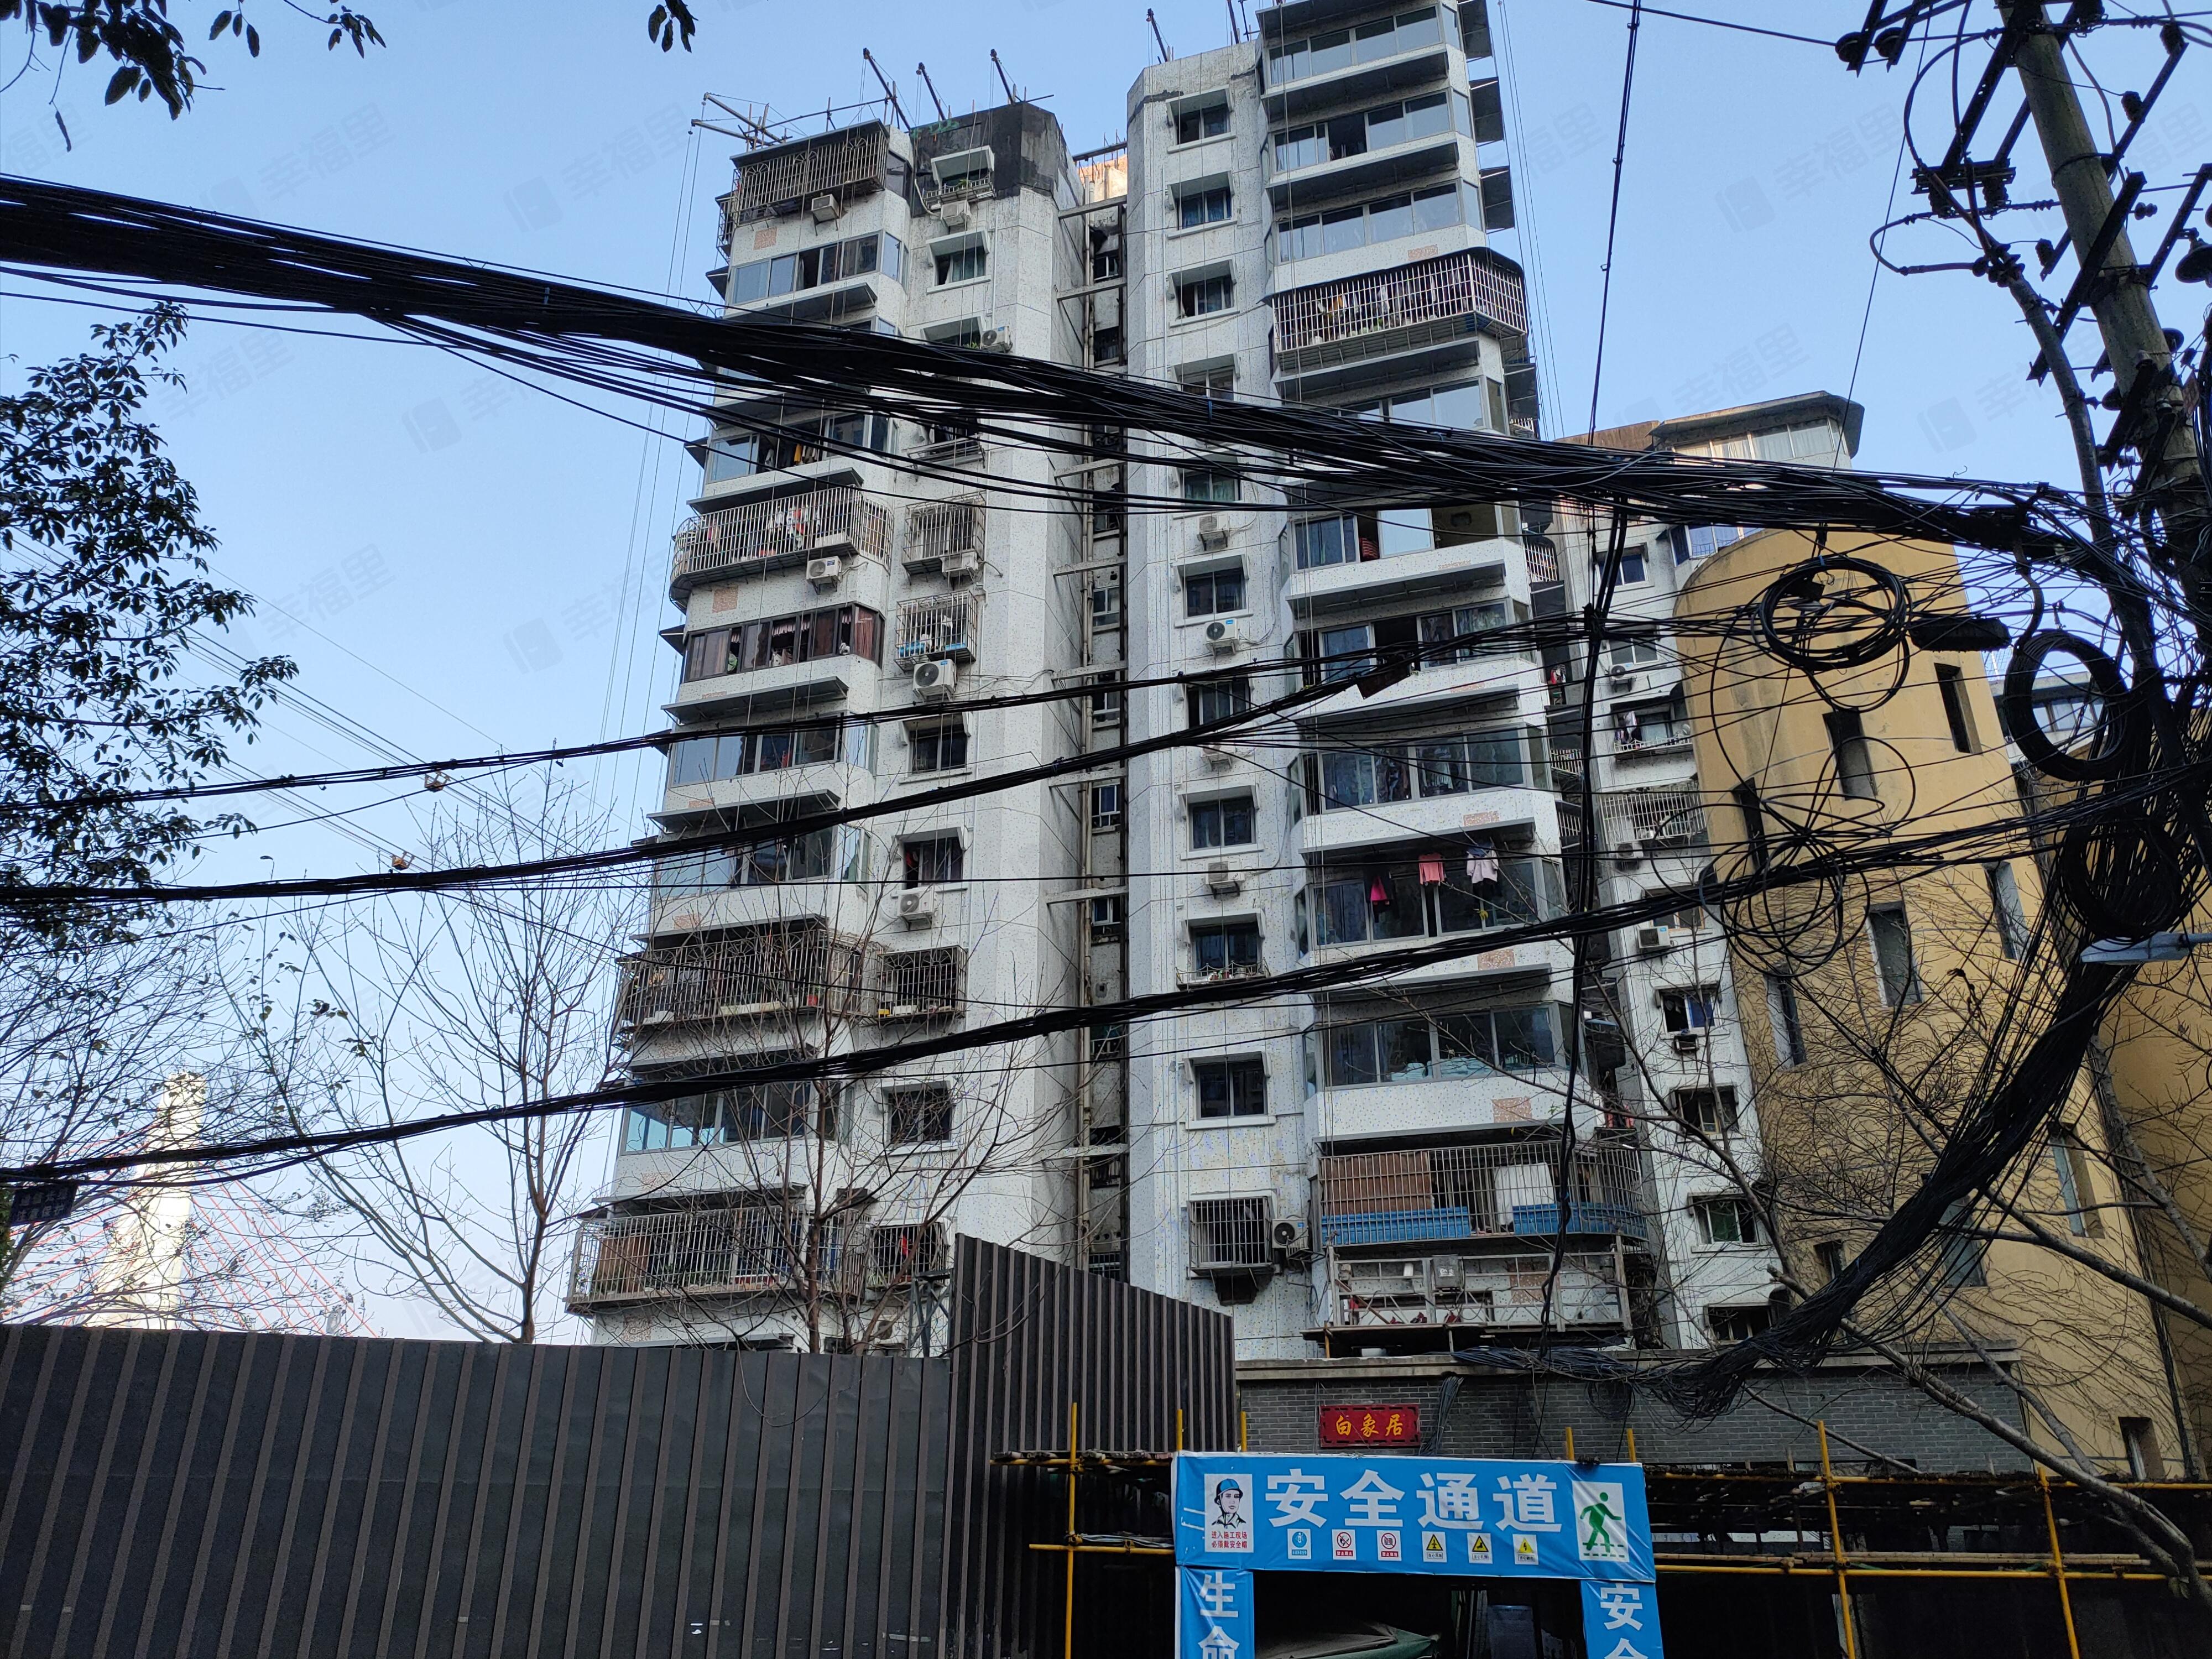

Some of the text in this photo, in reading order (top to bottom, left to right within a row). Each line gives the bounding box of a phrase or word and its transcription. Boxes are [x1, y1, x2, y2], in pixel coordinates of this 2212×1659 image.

[1335, 1413, 1403, 1437] 白象居
[1265, 1468, 1562, 1532] 安全通道
[1211, 1531, 1248, 1539] 进入施工现场
[1211, 1540, 1248, 1548] 必须戴安全帽
[1198, 1571, 1240, 1658] 生命
